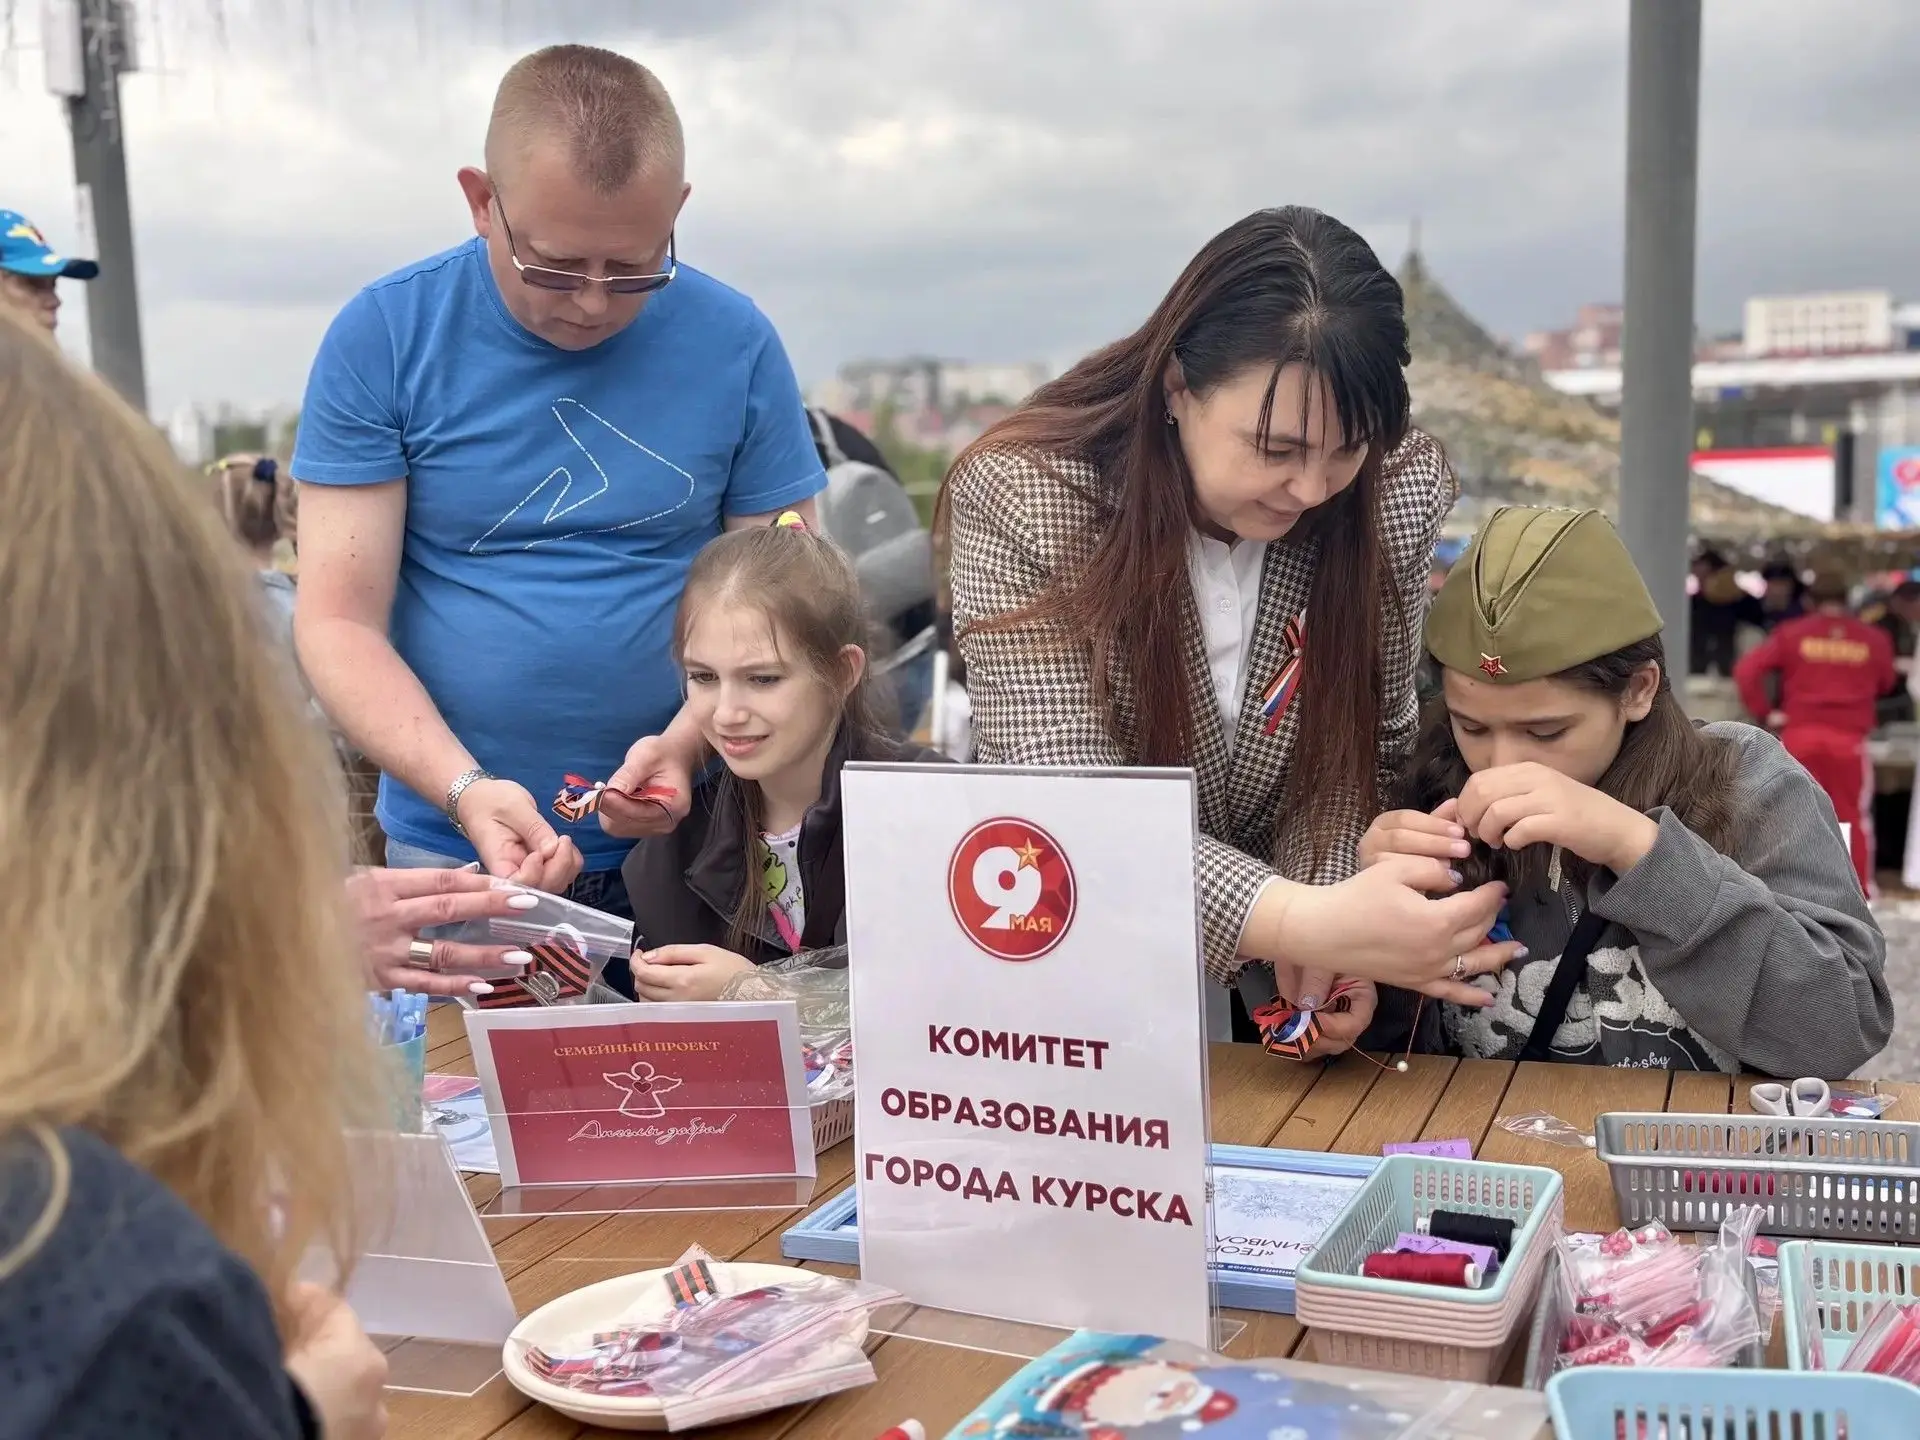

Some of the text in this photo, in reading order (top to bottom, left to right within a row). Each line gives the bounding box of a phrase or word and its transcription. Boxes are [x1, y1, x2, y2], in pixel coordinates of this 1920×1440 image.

[972, 845, 1042, 930] 9
[1009, 913, 1053, 933] МАЯ
[553, 1041, 721, 1057] СЕМЕЙНЫЙ ПРОЕКТ
[928, 1024, 1109, 1070] КОМИТЕТ
[567, 1119, 664, 1142] Ангелы
[881, 1087, 1170, 1150] ОБРАЗОВАНИЯ
[865, 1153, 1020, 1203] ГОРОДА
[1032, 1175, 1193, 1226] КУРСКА
